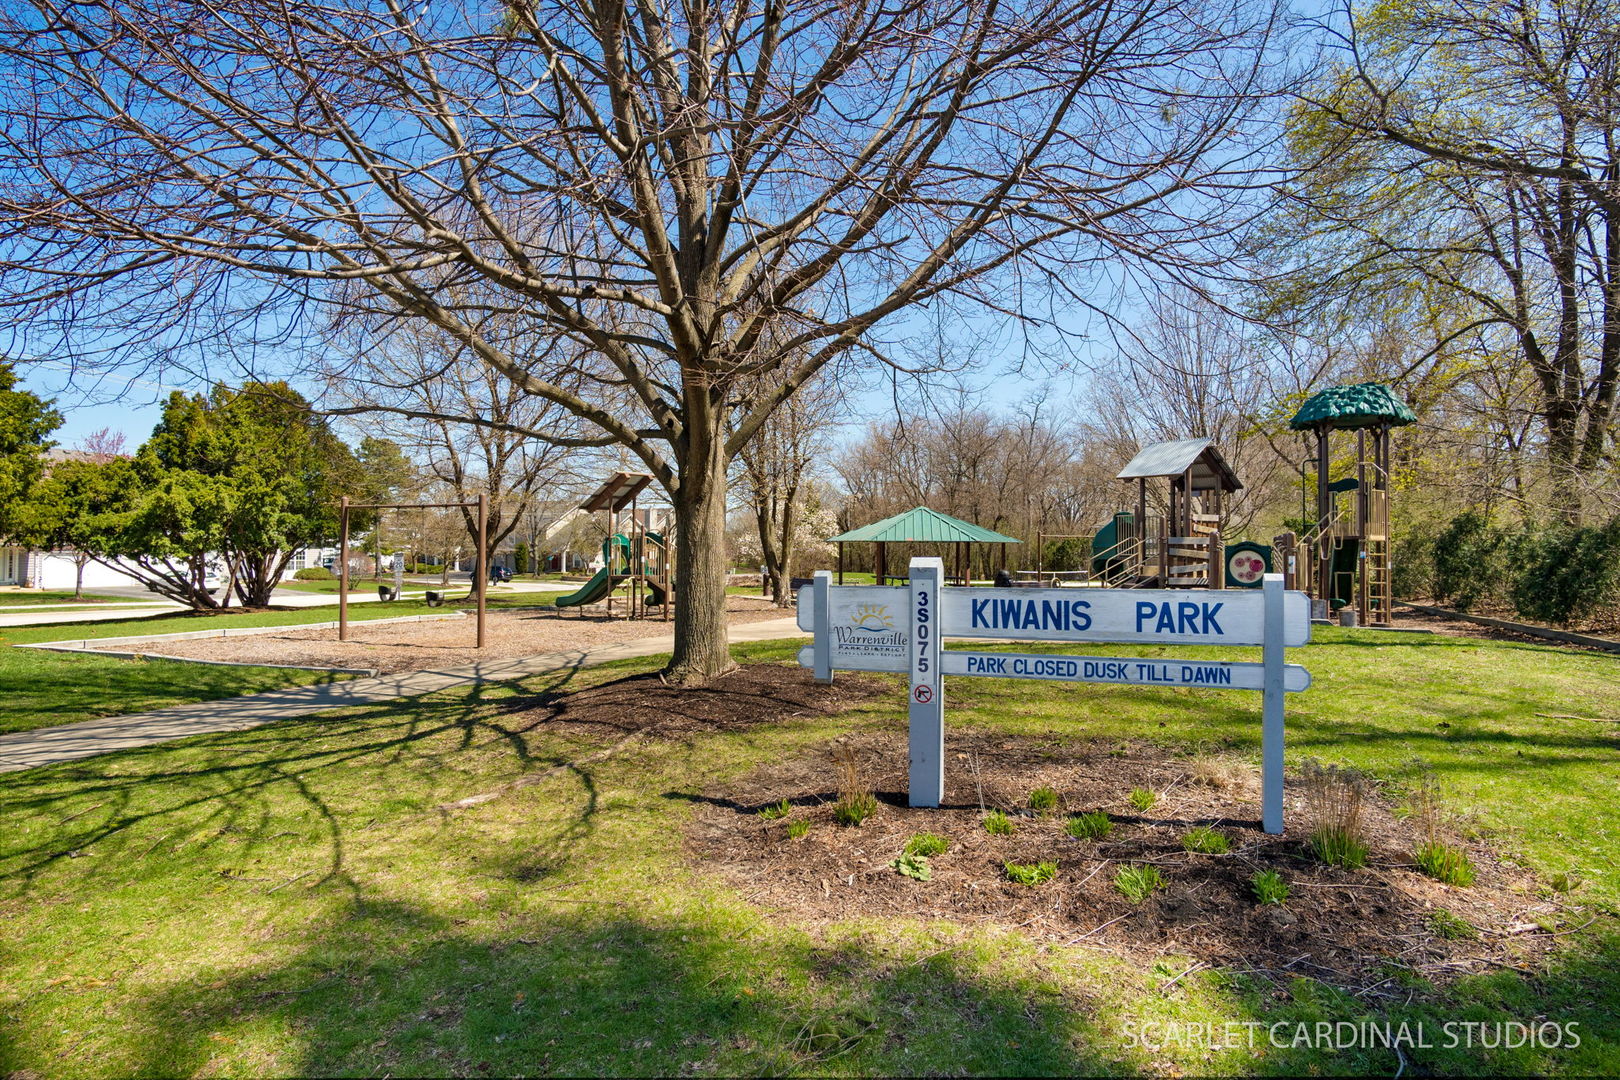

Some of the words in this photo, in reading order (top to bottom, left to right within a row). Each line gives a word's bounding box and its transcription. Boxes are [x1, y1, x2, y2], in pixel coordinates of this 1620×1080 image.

[917, 591, 929, 673] 3S075
[971, 598, 1092, 631] KIWANIS
[1136, 601, 1224, 635] PARK
[833, 626, 908, 645] Warrenville
[967, 656, 1006, 674] PARK
[1013, 659, 1077, 677] CLOSED
[1084, 661, 1129, 680] DUSK
[1136, 664, 1174, 682] TILL
[1181, 666, 1231, 684] DAWN
